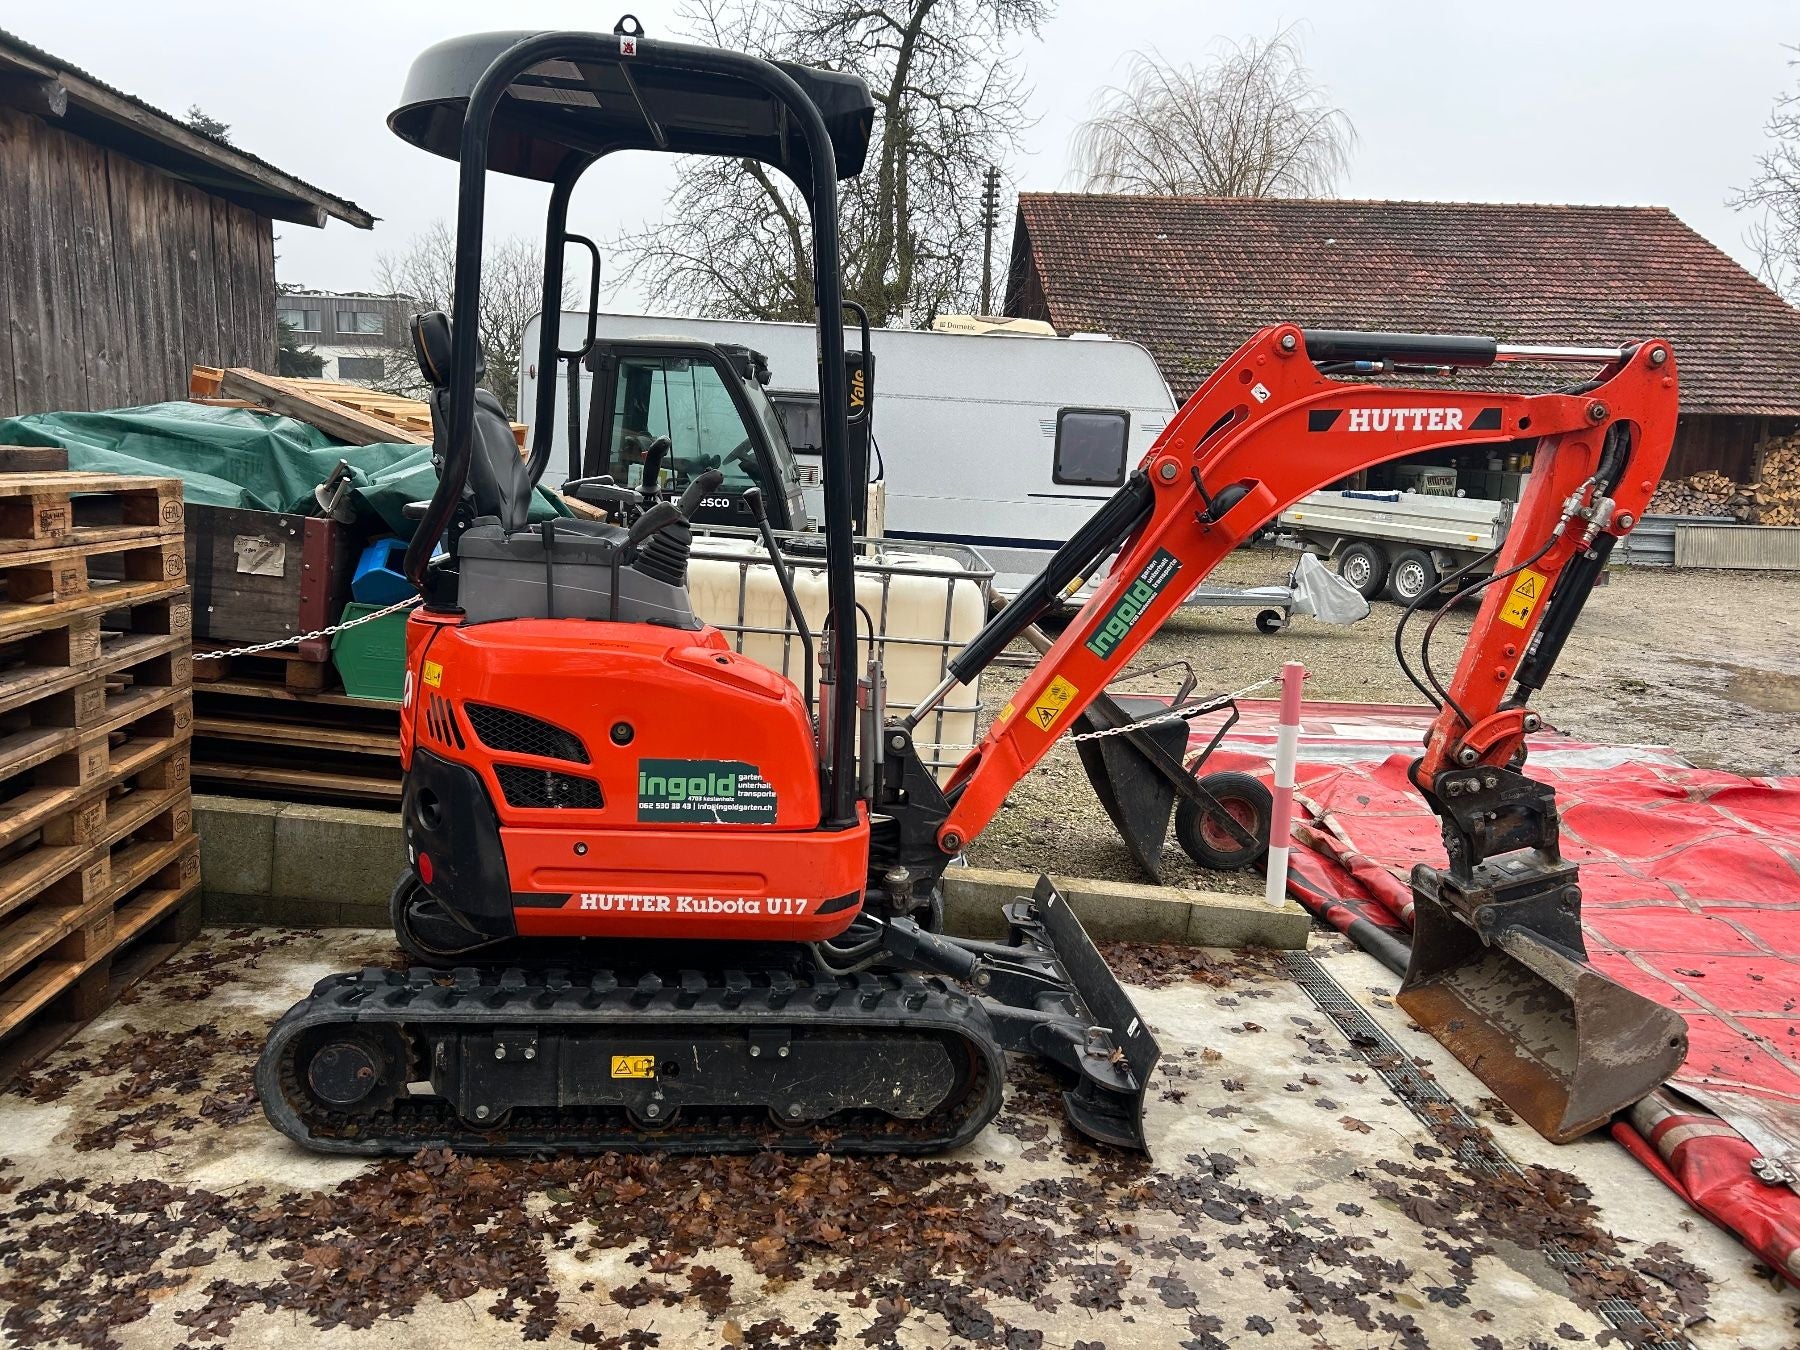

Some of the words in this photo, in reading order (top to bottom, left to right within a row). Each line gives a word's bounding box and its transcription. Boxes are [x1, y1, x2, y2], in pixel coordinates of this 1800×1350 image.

[850, 369, 865, 407] Yale
[1348, 407, 1463, 432] HUTTER
[699, 497, 730, 508] esco
[1140, 559, 1159, 581] garten
[1146, 557, 1170, 584] unterhalt
[1086, 578, 1154, 658] ingold
[638, 771, 736, 801] ingold
[737, 781, 772, 790] unterhalt
[738, 773, 763, 782] garten
[737, 790, 776, 799] transporte
[638, 802, 654, 810] 062
[655, 802, 670, 810] 530
[580, 893, 671, 913] HUTTER
[676, 896, 760, 915] Kubota
[766, 898, 808, 915] U17
